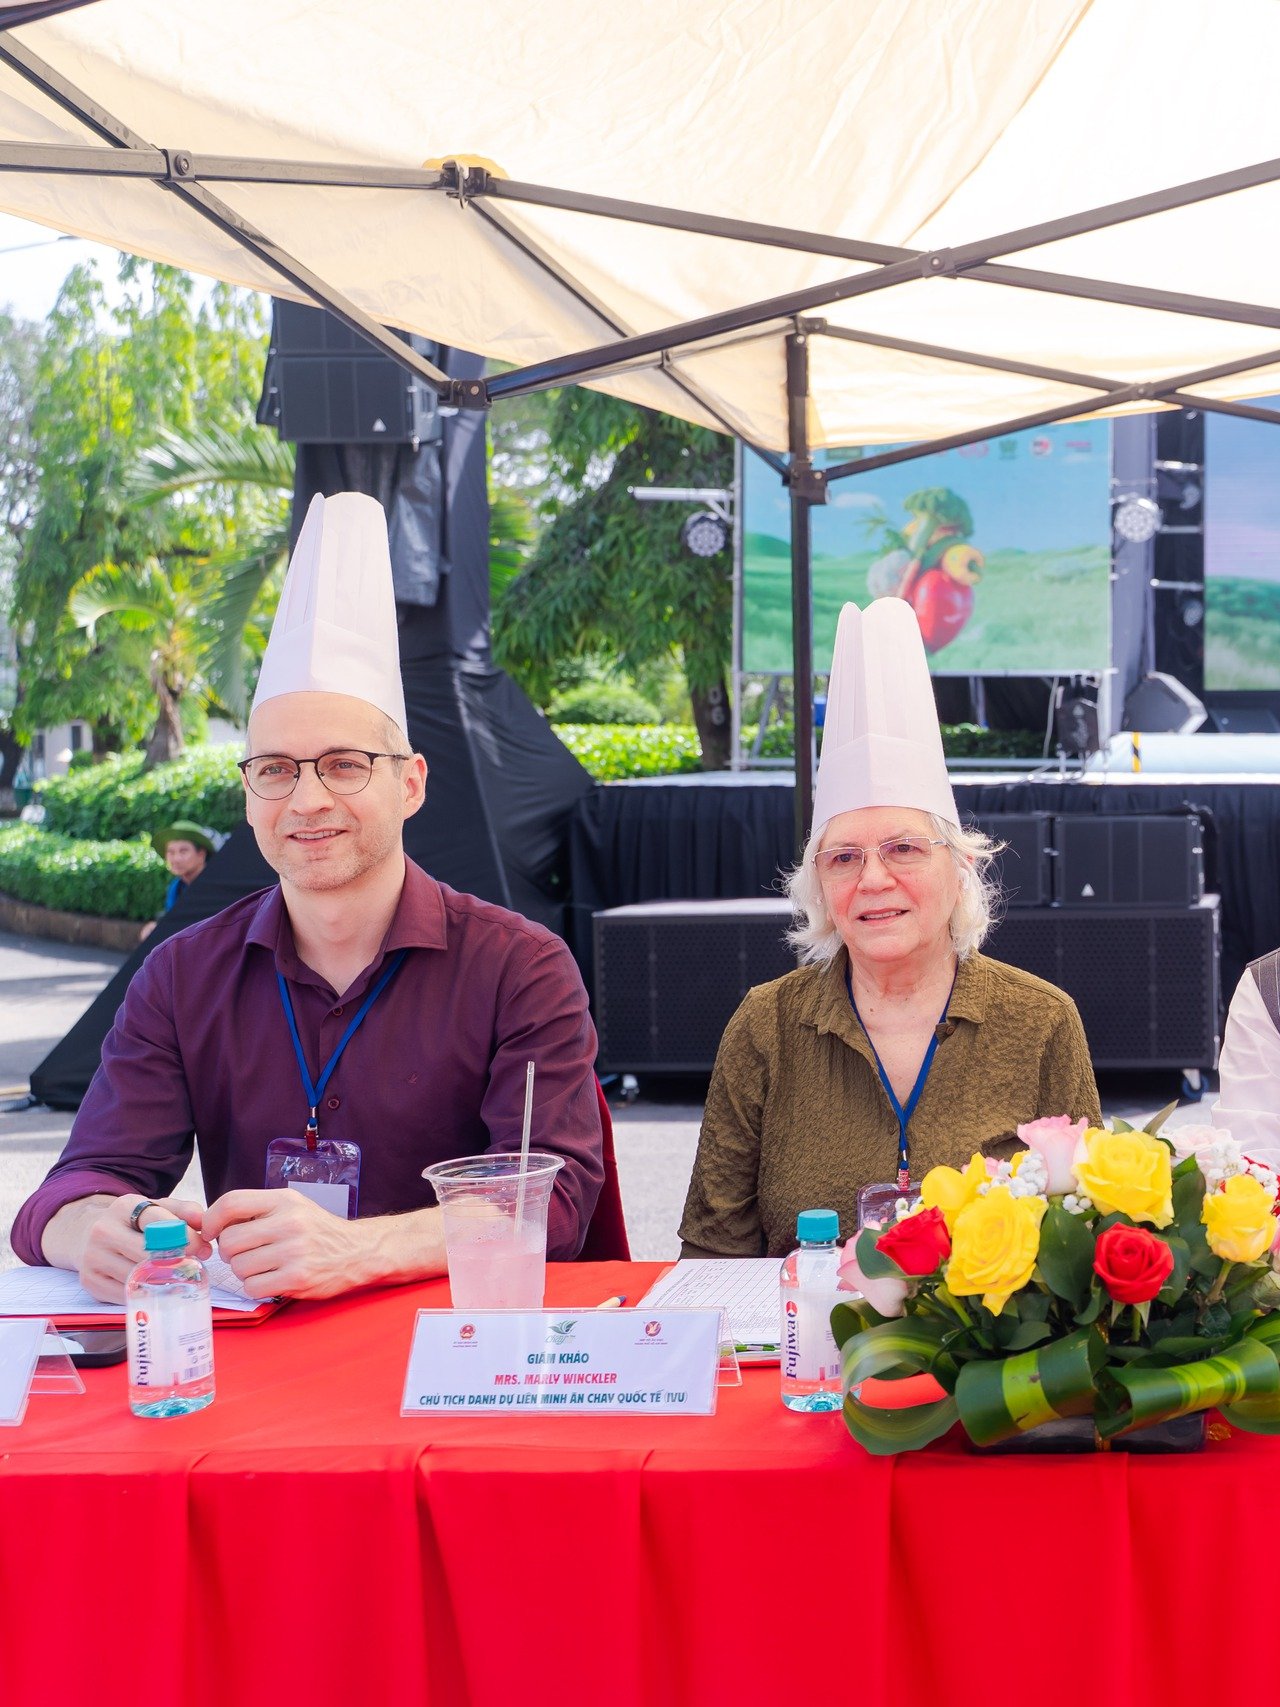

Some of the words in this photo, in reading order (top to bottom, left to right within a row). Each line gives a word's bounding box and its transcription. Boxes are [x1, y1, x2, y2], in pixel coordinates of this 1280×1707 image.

[527, 1351, 556, 1364] GIÁM
[558, 1350, 590, 1364] KHẢO
[786, 1320, 801, 1378] Fujiwa
[494, 1374, 521, 1386] MRS.
[524, 1374, 561, 1384] MARLY
[563, 1373, 618, 1384] WINCKLER
[420, 1393, 441, 1406] CHỦ
[443, 1394, 466, 1406] TỊCH
[468, 1394, 496, 1405] DANH
[499, 1393, 514, 1406] DỰ
[516, 1392, 538, 1404] LIÊN
[541, 1394, 568, 1404] MINH
[587, 1393, 615, 1404] CHAY
[617, 1389, 647, 1404] QUỐC
[650, 1388, 664, 1403] TẾ
[664, 1392, 688, 1404] (IVU)
